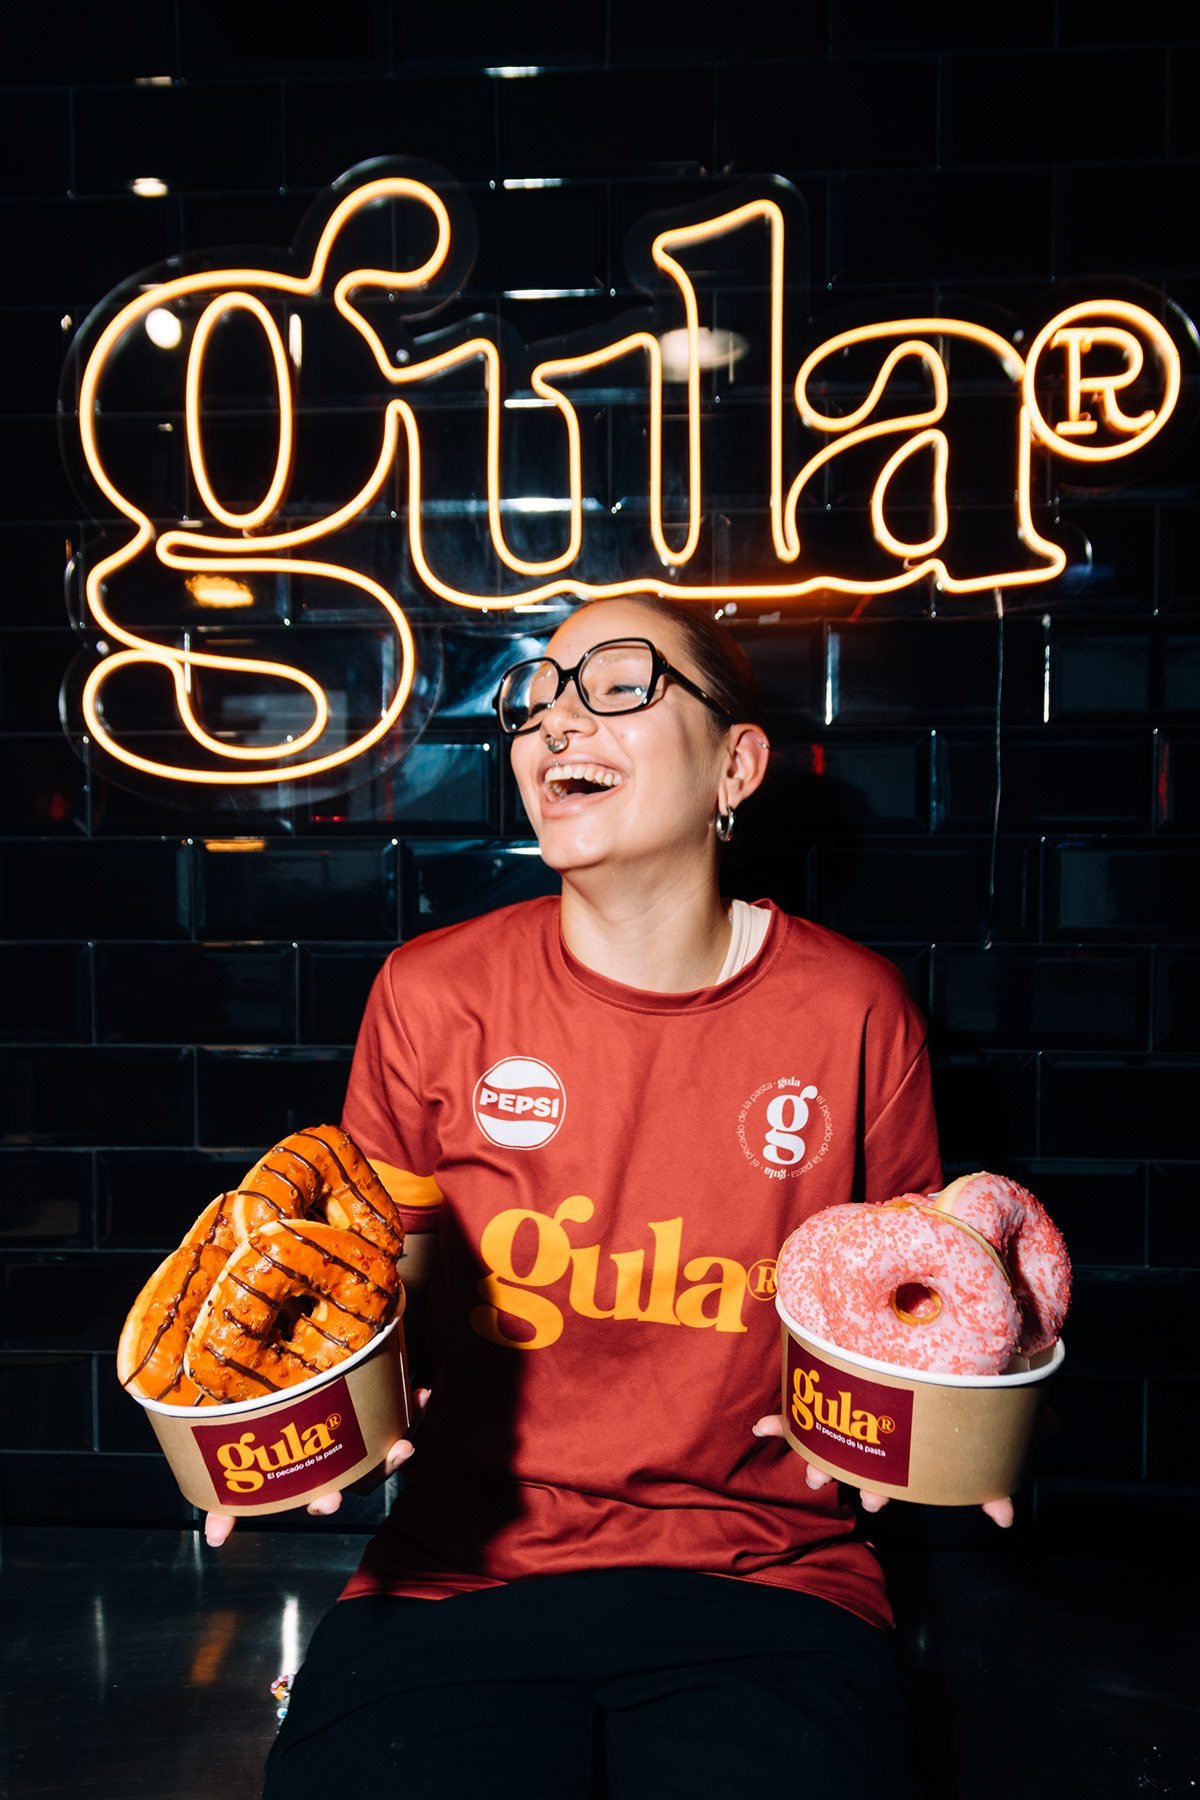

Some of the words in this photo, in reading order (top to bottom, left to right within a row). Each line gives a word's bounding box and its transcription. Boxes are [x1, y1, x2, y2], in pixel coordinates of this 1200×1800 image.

[749, 1082, 773, 1102] pasta
[777, 1076, 801, 1089] gula
[479, 1087, 560, 1118] PEPSI
[737, 1109, 748, 1123] de
[762, 1085, 818, 1165] g
[819, 1104, 834, 1142] pecado
[736, 1124, 755, 1160] pecado
[818, 1142, 830, 1156] de
[763, 1166, 787, 1180] gula
[791, 1161, 813, 1178] pasta
[815, 1421, 822, 1431] El
[822, 1427, 846, 1444] pecado
[846, 1438, 856, 1448] de
[856, 1443, 864, 1451] la
[864, 1445, 886, 1457] pasta
[266, 1472, 275, 1480] El
[275, 1462, 304, 1478] pecado
[304, 1458, 315, 1467] de
[315, 1453, 323, 1462] la
[323, 1443, 343, 1459] pasta
